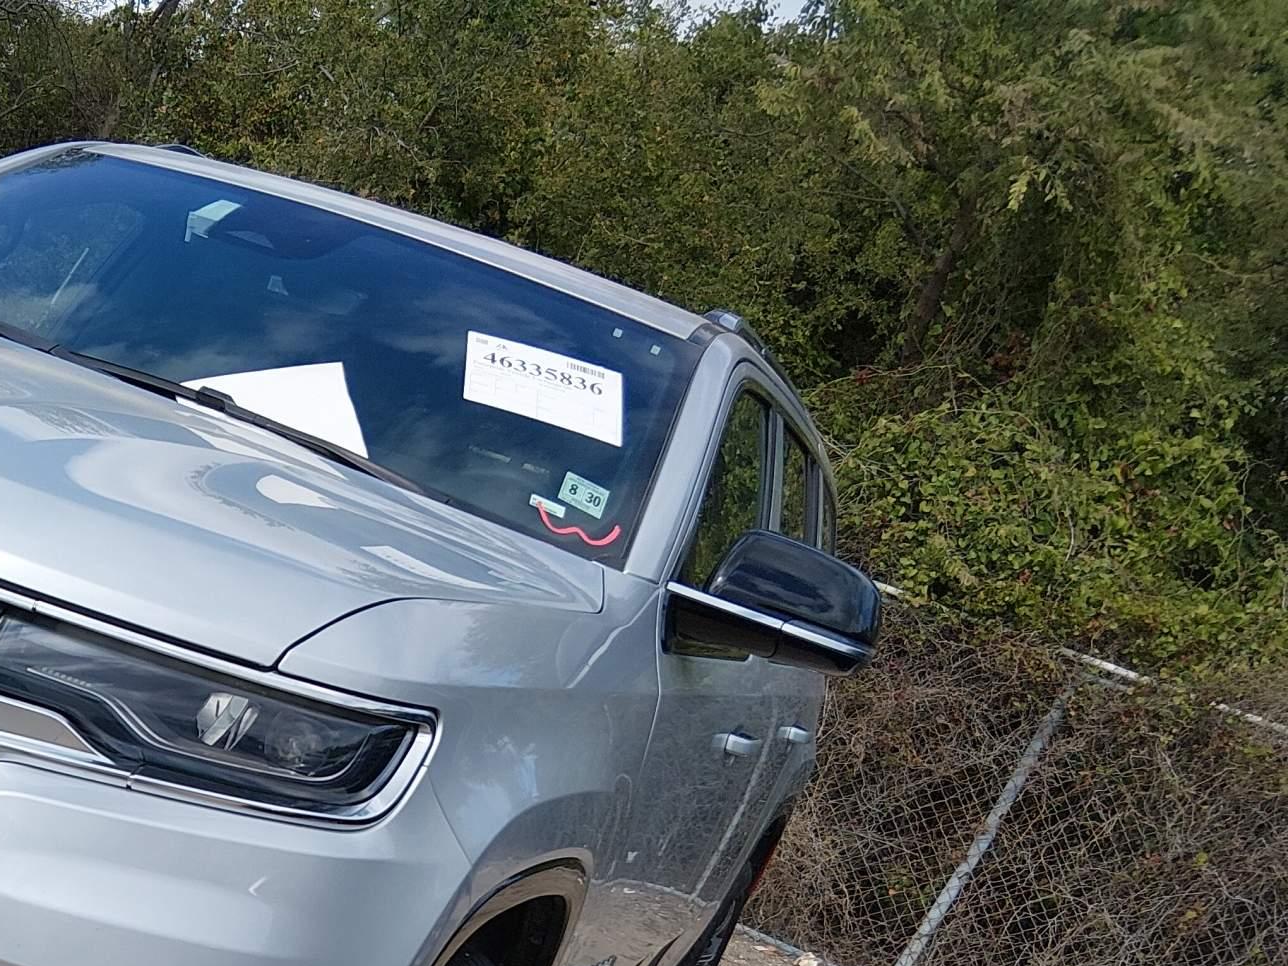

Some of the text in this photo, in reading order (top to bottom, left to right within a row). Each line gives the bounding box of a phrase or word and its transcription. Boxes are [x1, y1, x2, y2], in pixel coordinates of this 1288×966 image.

[482, 351, 604, 396] 46335836
[568, 483, 579, 496] 8
[584, 491, 602, 508] 30
